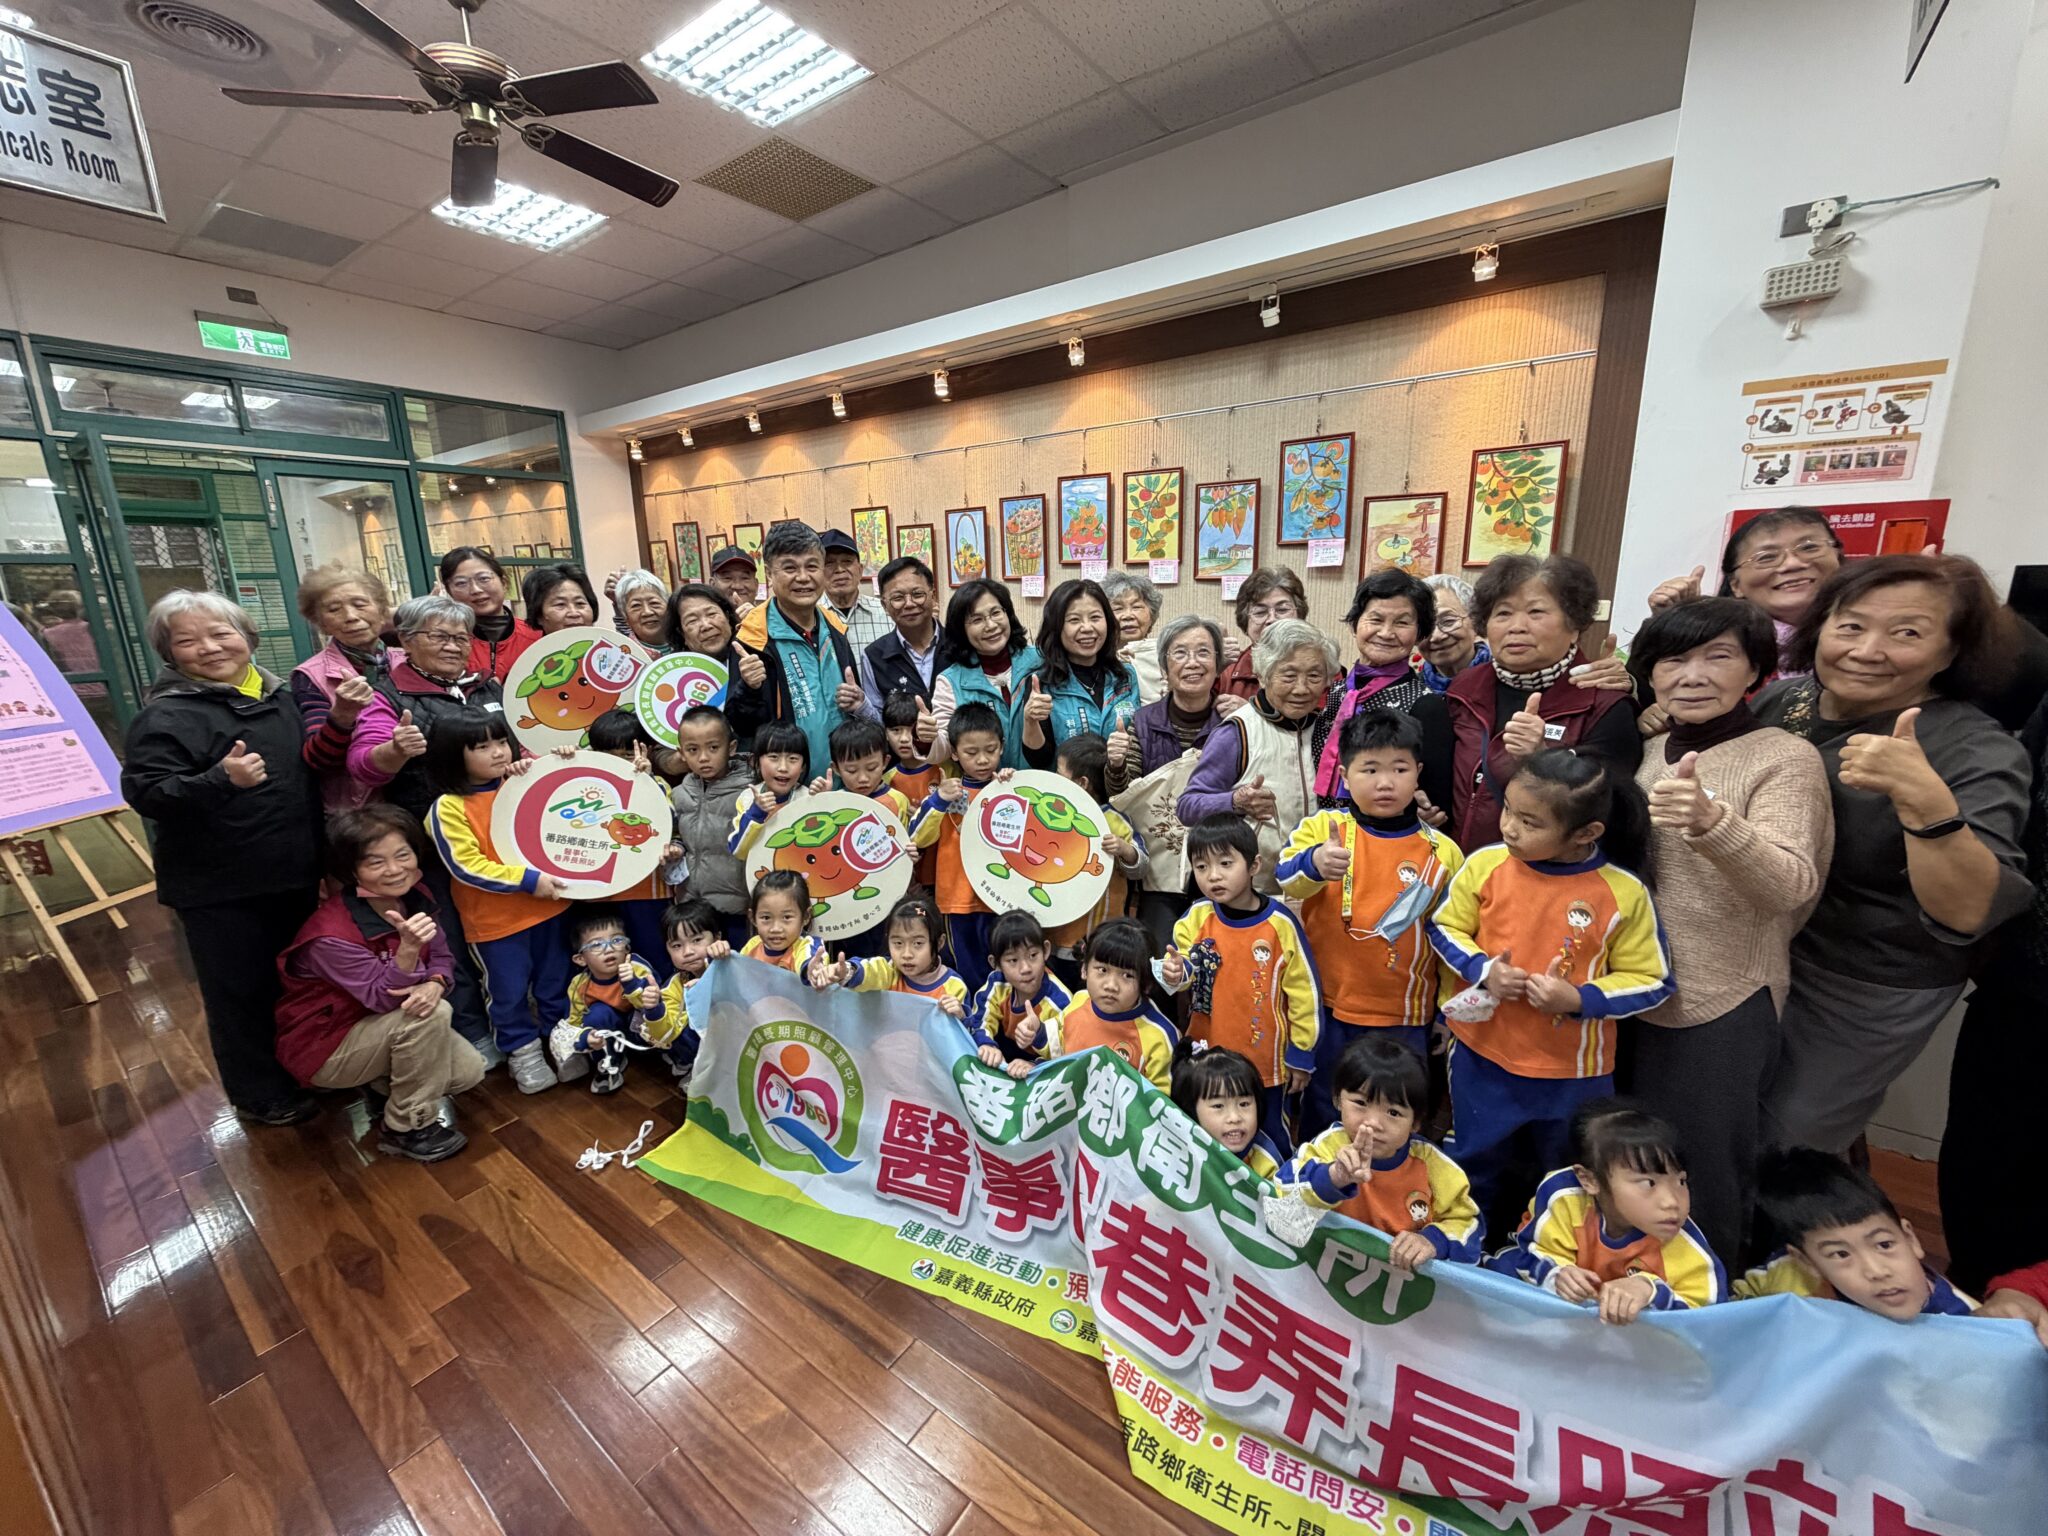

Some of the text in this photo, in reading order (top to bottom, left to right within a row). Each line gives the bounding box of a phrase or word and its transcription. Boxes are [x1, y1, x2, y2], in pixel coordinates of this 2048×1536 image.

[61, 138, 121, 184] Room
[545, 832, 610, 851] 番路鄉衛生所
[785, 1088, 828, 1126] 1966
[932, 1267, 1037, 1318] 嘉義縣政府
